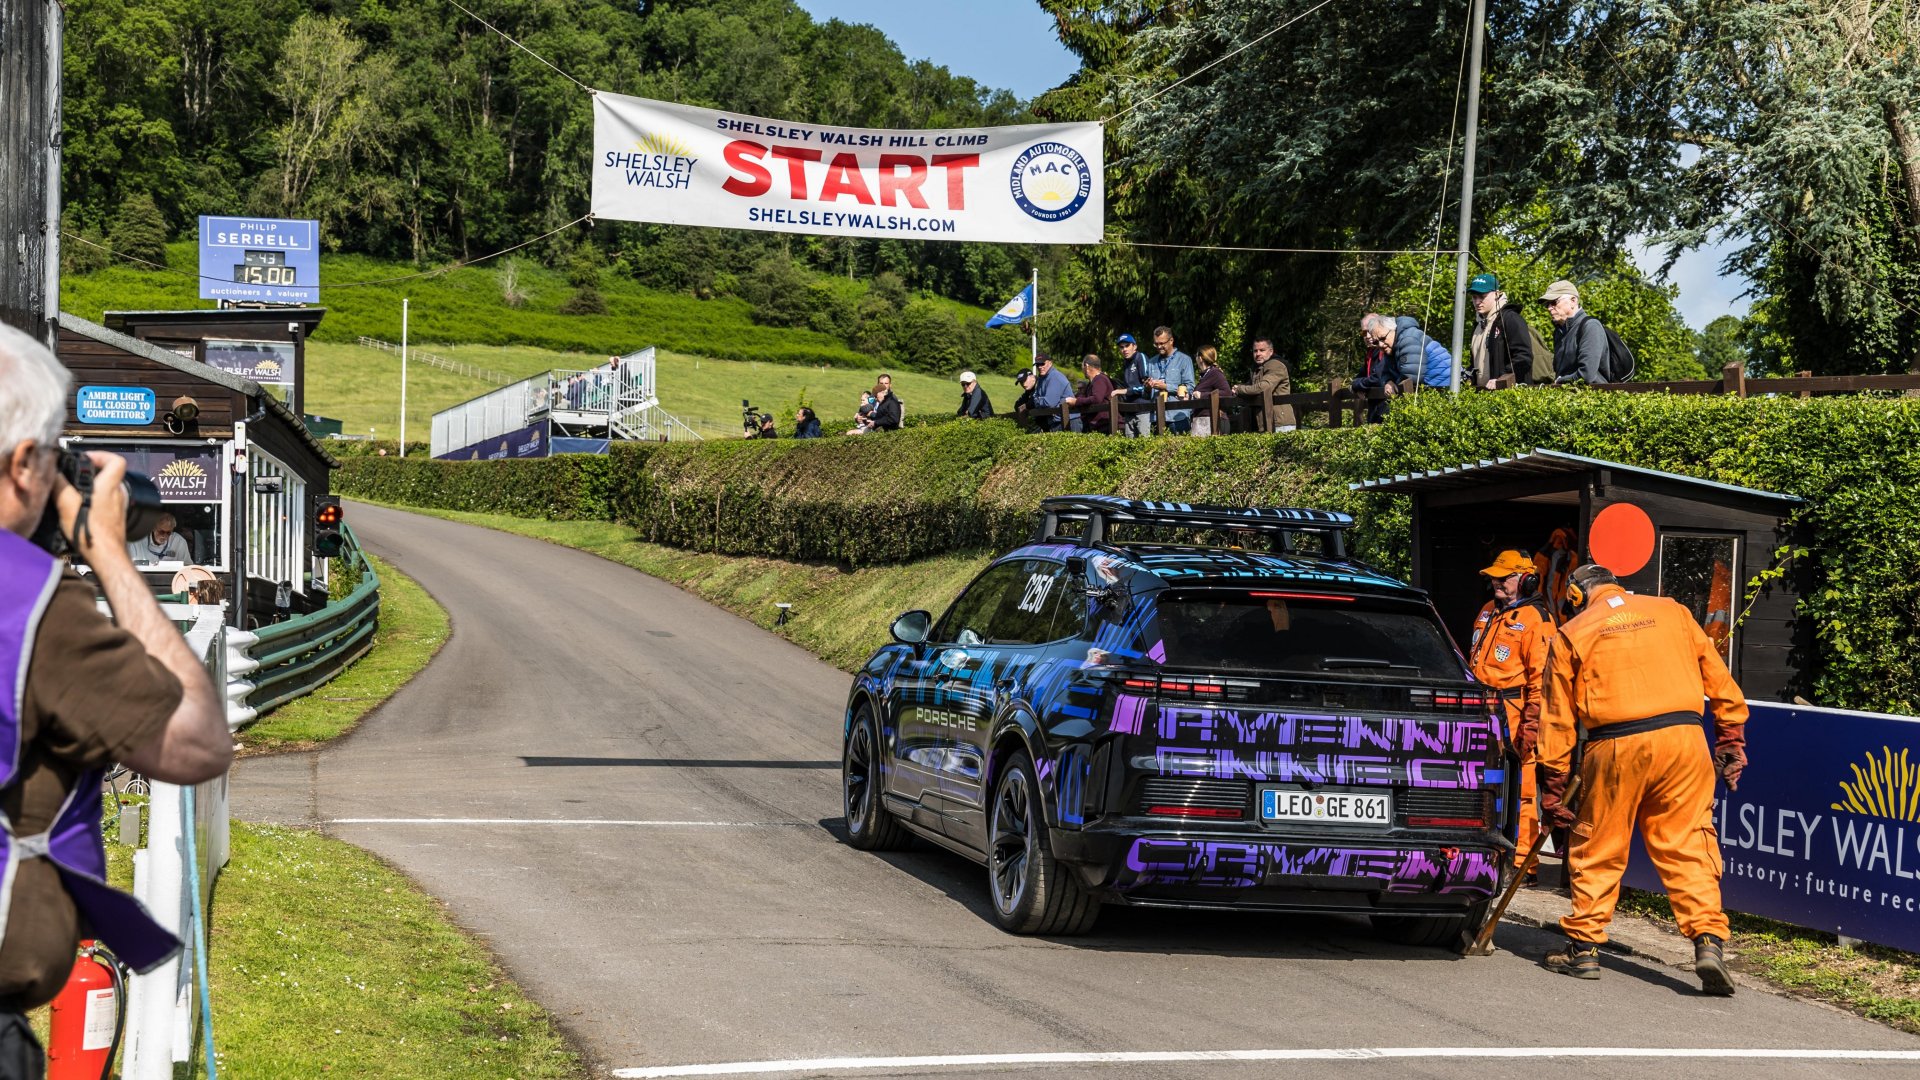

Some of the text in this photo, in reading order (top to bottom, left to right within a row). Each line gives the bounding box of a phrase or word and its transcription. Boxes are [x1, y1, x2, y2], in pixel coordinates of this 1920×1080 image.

[717, 118, 988, 147] SHELSLEY WALSH HILL CLIMB
[605, 151, 698, 173] SHELSLEY
[1011, 144, 1090, 199] MIDLAND AUTOMOBILE CLUB
[1029, 161, 1072, 176] MAC
[625, 169, 690, 190] WALSH
[721, 139, 980, 211] START
[240, 222, 277, 232] PHILIP
[749, 207, 956, 233] SHELSLEYWALSH.COM
[217, 232, 299, 247] SERRELL
[210, 287, 260, 297] auctioneers
[277, 289, 308, 298] valuers
[255, 367, 281, 377] WALSH
[83, 400, 150, 411] HILL CLOSED TO
[87, 391, 146, 401] AMBER LIGHT
[86, 409, 146, 419] COMPETITORS
[159, 476, 207, 489] WALSH
[916, 706, 976, 732] PORSCHE
[1277, 794, 1312, 816] LEO
[1327, 797, 1349, 818] GE
[1354, 798, 1386, 819] 861
[1832, 816, 1920, 881] WAL
[1805, 871, 1872, 903] future
[1881, 891, 1920, 912] rec
